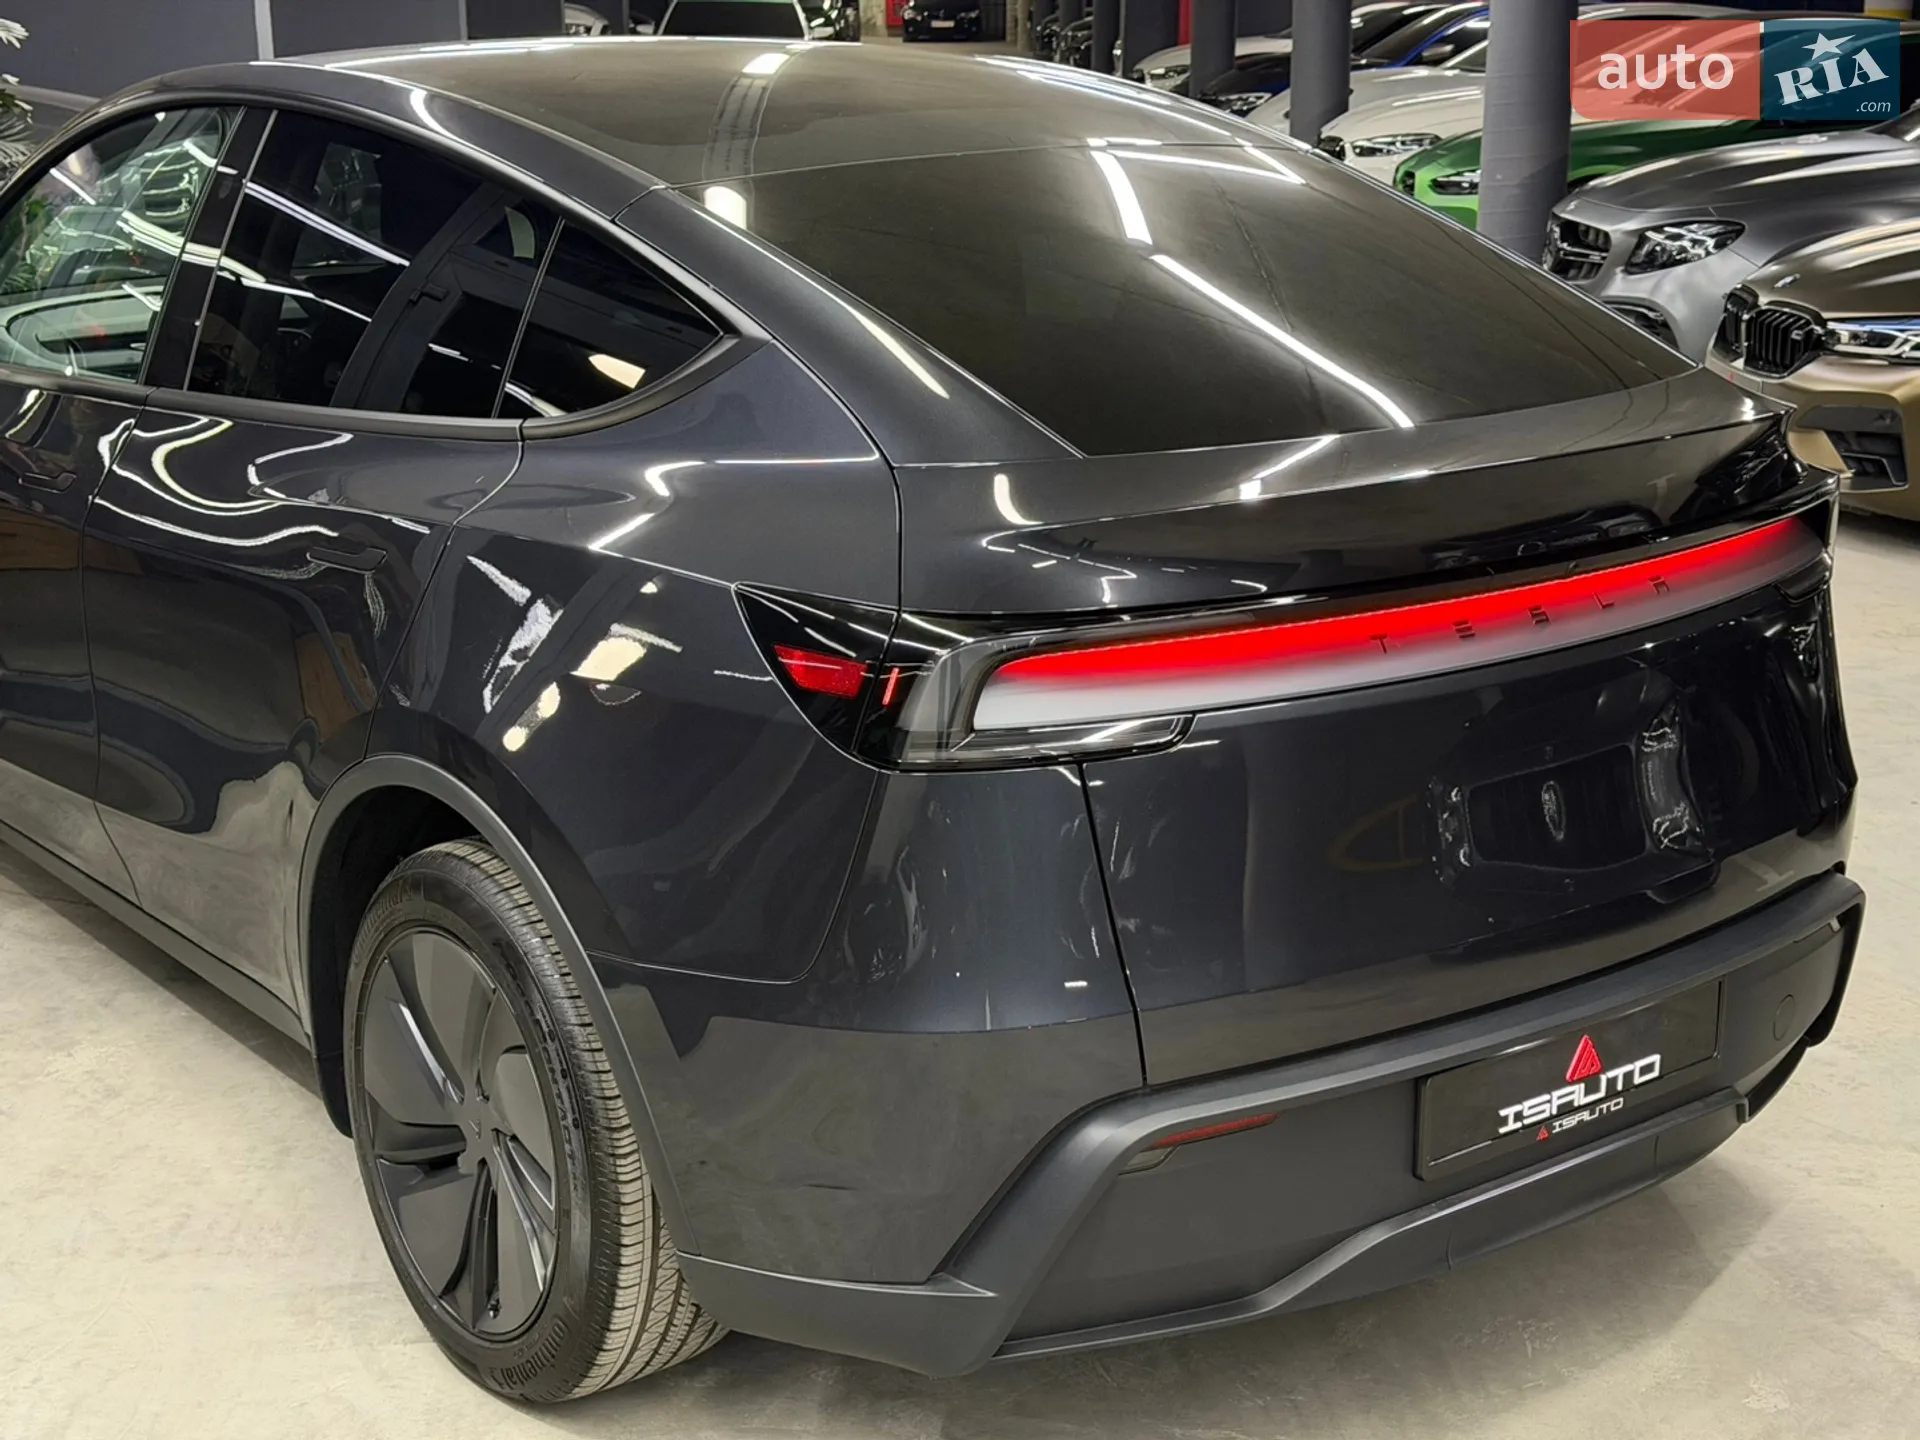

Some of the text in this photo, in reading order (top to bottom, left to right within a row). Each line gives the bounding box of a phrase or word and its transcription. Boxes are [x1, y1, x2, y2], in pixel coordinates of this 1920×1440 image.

[1369, 575, 1671, 655] TESLA
[1498, 1053, 1662, 1135] ISAUTO
[1551, 1097, 1624, 1135] ISAUTO
[499, 1314, 571, 1391] Continental
